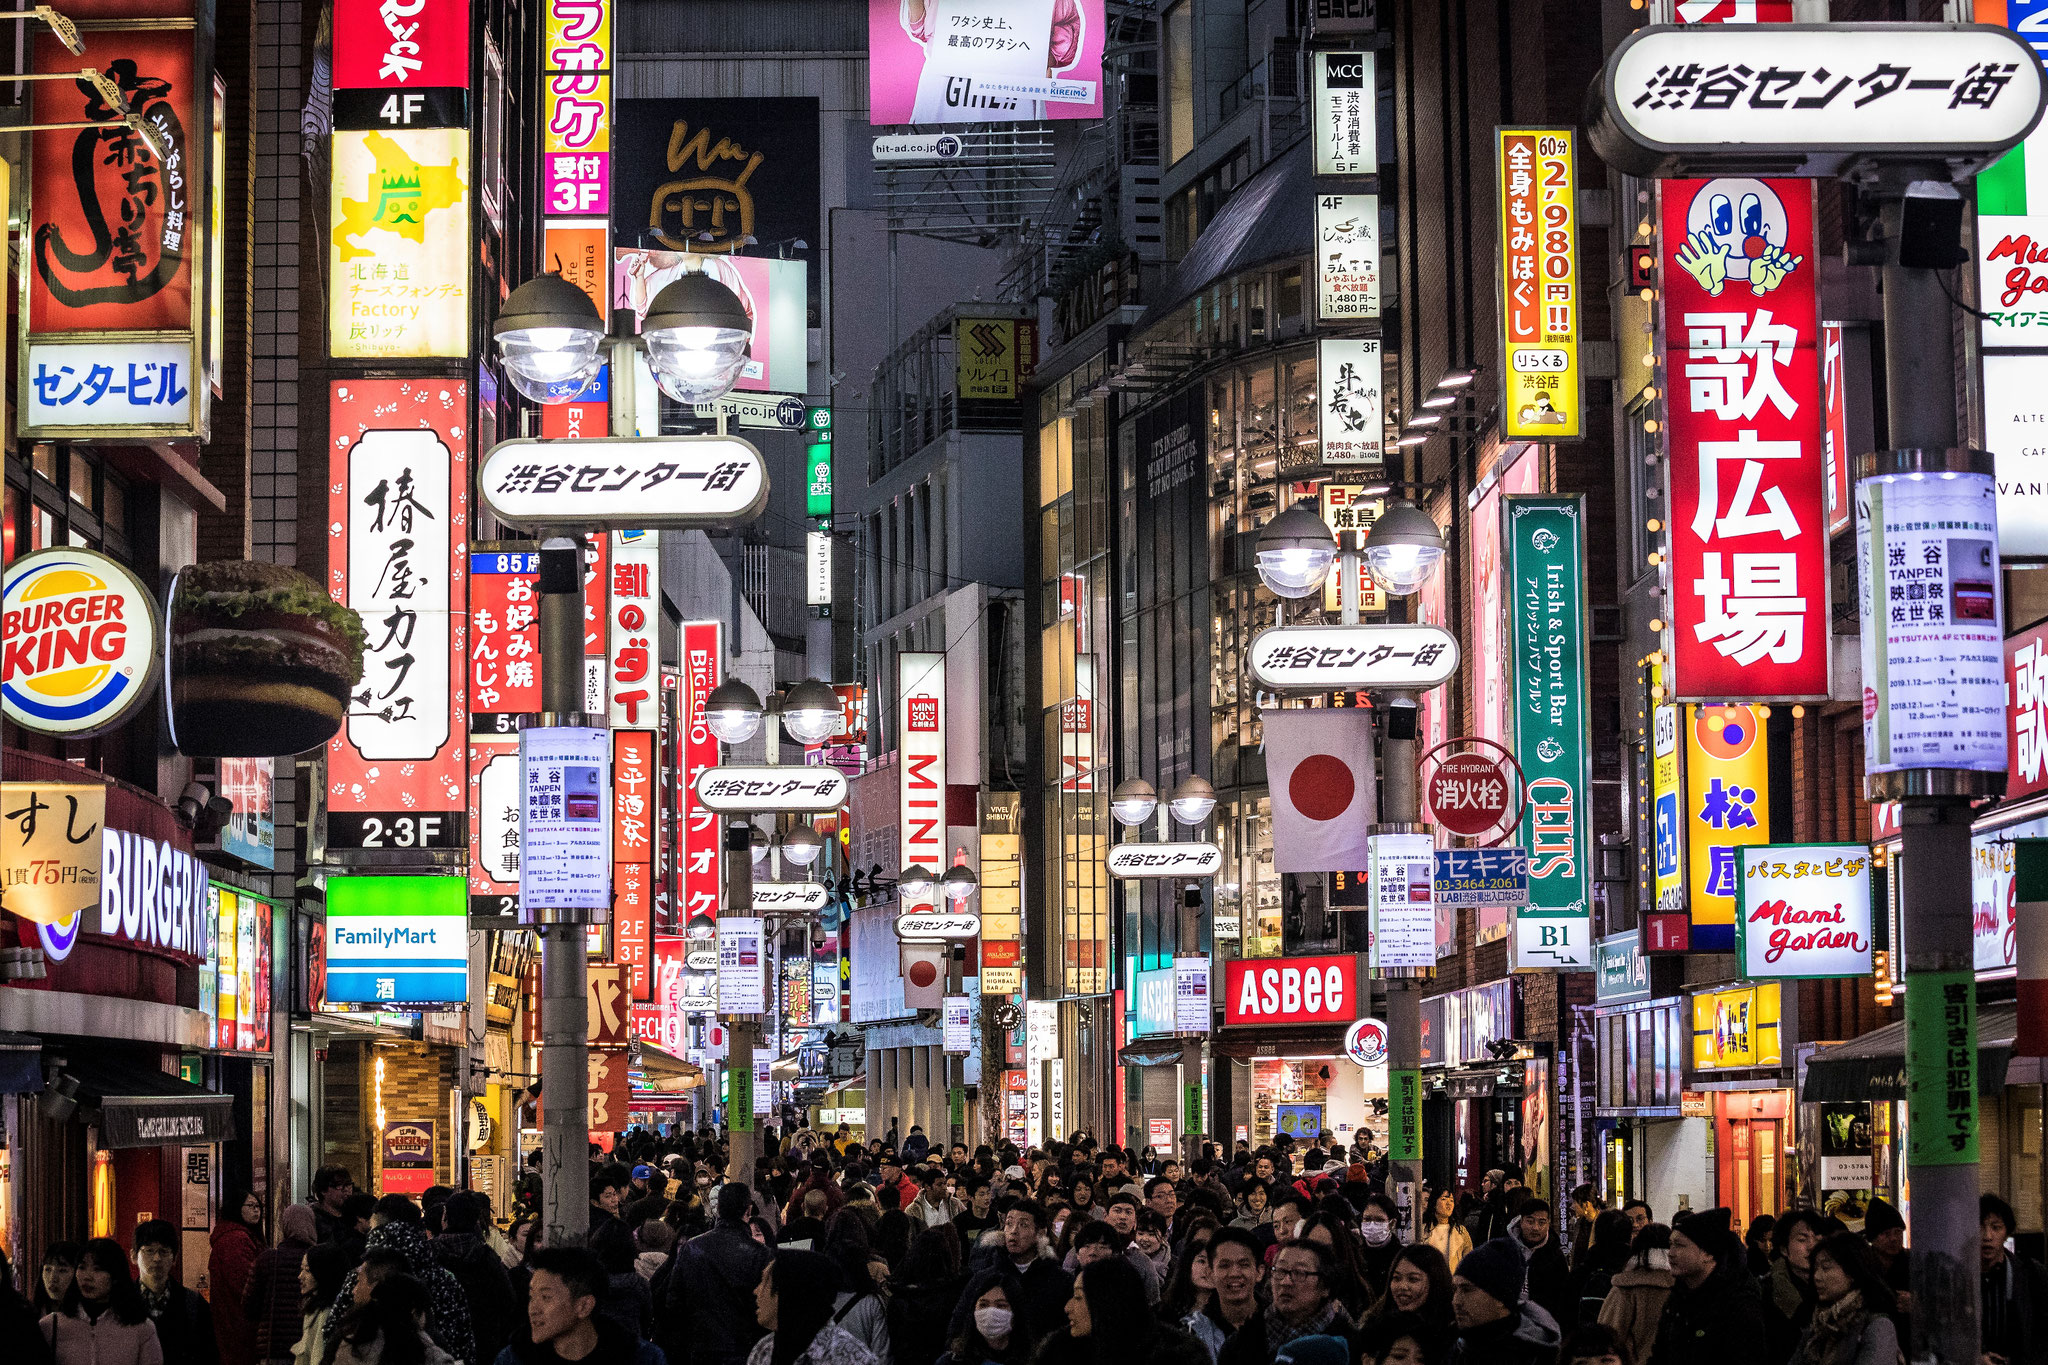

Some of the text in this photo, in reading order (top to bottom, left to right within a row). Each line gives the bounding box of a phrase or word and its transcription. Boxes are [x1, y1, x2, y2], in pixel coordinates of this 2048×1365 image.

[950, 15, 1013, 30] ワタシ史上、
[947, 34, 1030, 52] 最高のワタシへ
[1327, 64, 1363, 78] MCC
[1050, 86, 1088, 97] KIREIMO
[1633, 63, 2020, 110] 渋谷センター街
[379, 94, 425, 125] 4F
[1331, 95, 1345, 160] モニタールーム
[1347, 90, 1361, 156] 渋谷消費者
[876, 143, 937, 160] hit-ad.co.jp
[1539, 137, 1568, 156] 60分
[553, 155, 601, 181] 受付
[553, 184, 600, 211] 3F
[1322, 196, 1343, 210] 4F
[1507, 142, 1535, 336] 全身もみほぐし
[349, 263, 410, 281] 北海道
[1327, 263, 1347, 274] ラム
[1324, 274, 1376, 283] しゃぶしゃぶ
[1333, 283, 1369, 293] 食べ放題
[348, 283, 465, 299] チーズフォンデュ
[352, 302, 420, 324] Factory
[1362, 342, 1379, 354] 3F
[1517, 354, 1564, 369] りらくる
[33, 362, 188, 406] センタービル
[966, 368, 1010, 382] ソレイユ
[1523, 374, 1560, 390] 渋谷店
[1326, 441, 1380, 451] 焼肉食べ放題
[496, 462, 751, 494] 渋谷センター街
[1684, 308, 1807, 667] 歌広場
[1889, 567, 1944, 580] TANPEN
[362, 466, 436, 723] 椿屋カフェ
[2, 594, 125, 641] BURGER
[1891, 604, 1945, 622] 佐世保
[505, 576, 534, 689] お好み焼
[1526, 576, 1542, 673] アイリッシュパブ
[1544, 564, 1568, 727] Irish & Sport Bar
[1901, 635, 1940, 643] TSUTAYA
[2, 621, 128, 682] KING
[473, 607, 500, 709] もんじゃ
[1261, 643, 1448, 669] 渋谷センター街
[689, 650, 708, 745] BIG ECHO
[912, 702, 935, 712] MINI
[529, 770, 561, 783] 渋谷
[1441, 763, 1495, 774] FIRE HYDRANT
[529, 784, 561, 793] TANPEN
[704, 779, 840, 797] 渋谷センター街
[1435, 778, 1504, 810] 消火栓
[5, 790, 98, 848] すし
[529, 808, 561, 819] 佐世保
[986, 813, 1013, 821] SHIBUYA
[1113, 852, 1217, 867] 渋谷センター街
[1746, 857, 1866, 880] パスタとピザ
[101, 826, 193, 955] BURGER
[624, 864, 641, 905] 渋谷店
[1435, 877, 1519, 891] 03-3464-2061
[752, 891, 822, 903] 谷センター街
[1748, 899, 1846, 926] Miami
[620, 920, 644, 935] 2F
[900, 920, 976, 931] 渋谷センター街
[1651, 919, 1679, 948] 1F
[335, 927, 437, 949] FamilyMart
[1539, 925, 1571, 946] B1
[620, 945, 644, 962] 3F
[1764, 927, 1869, 964] garden
[375, 978, 396, 1000] 酒
[1238, 965, 1344, 1016] ASBee
[789, 984, 799, 1022] ハンバー
[1683, 1100, 1706, 1109] SECOM
